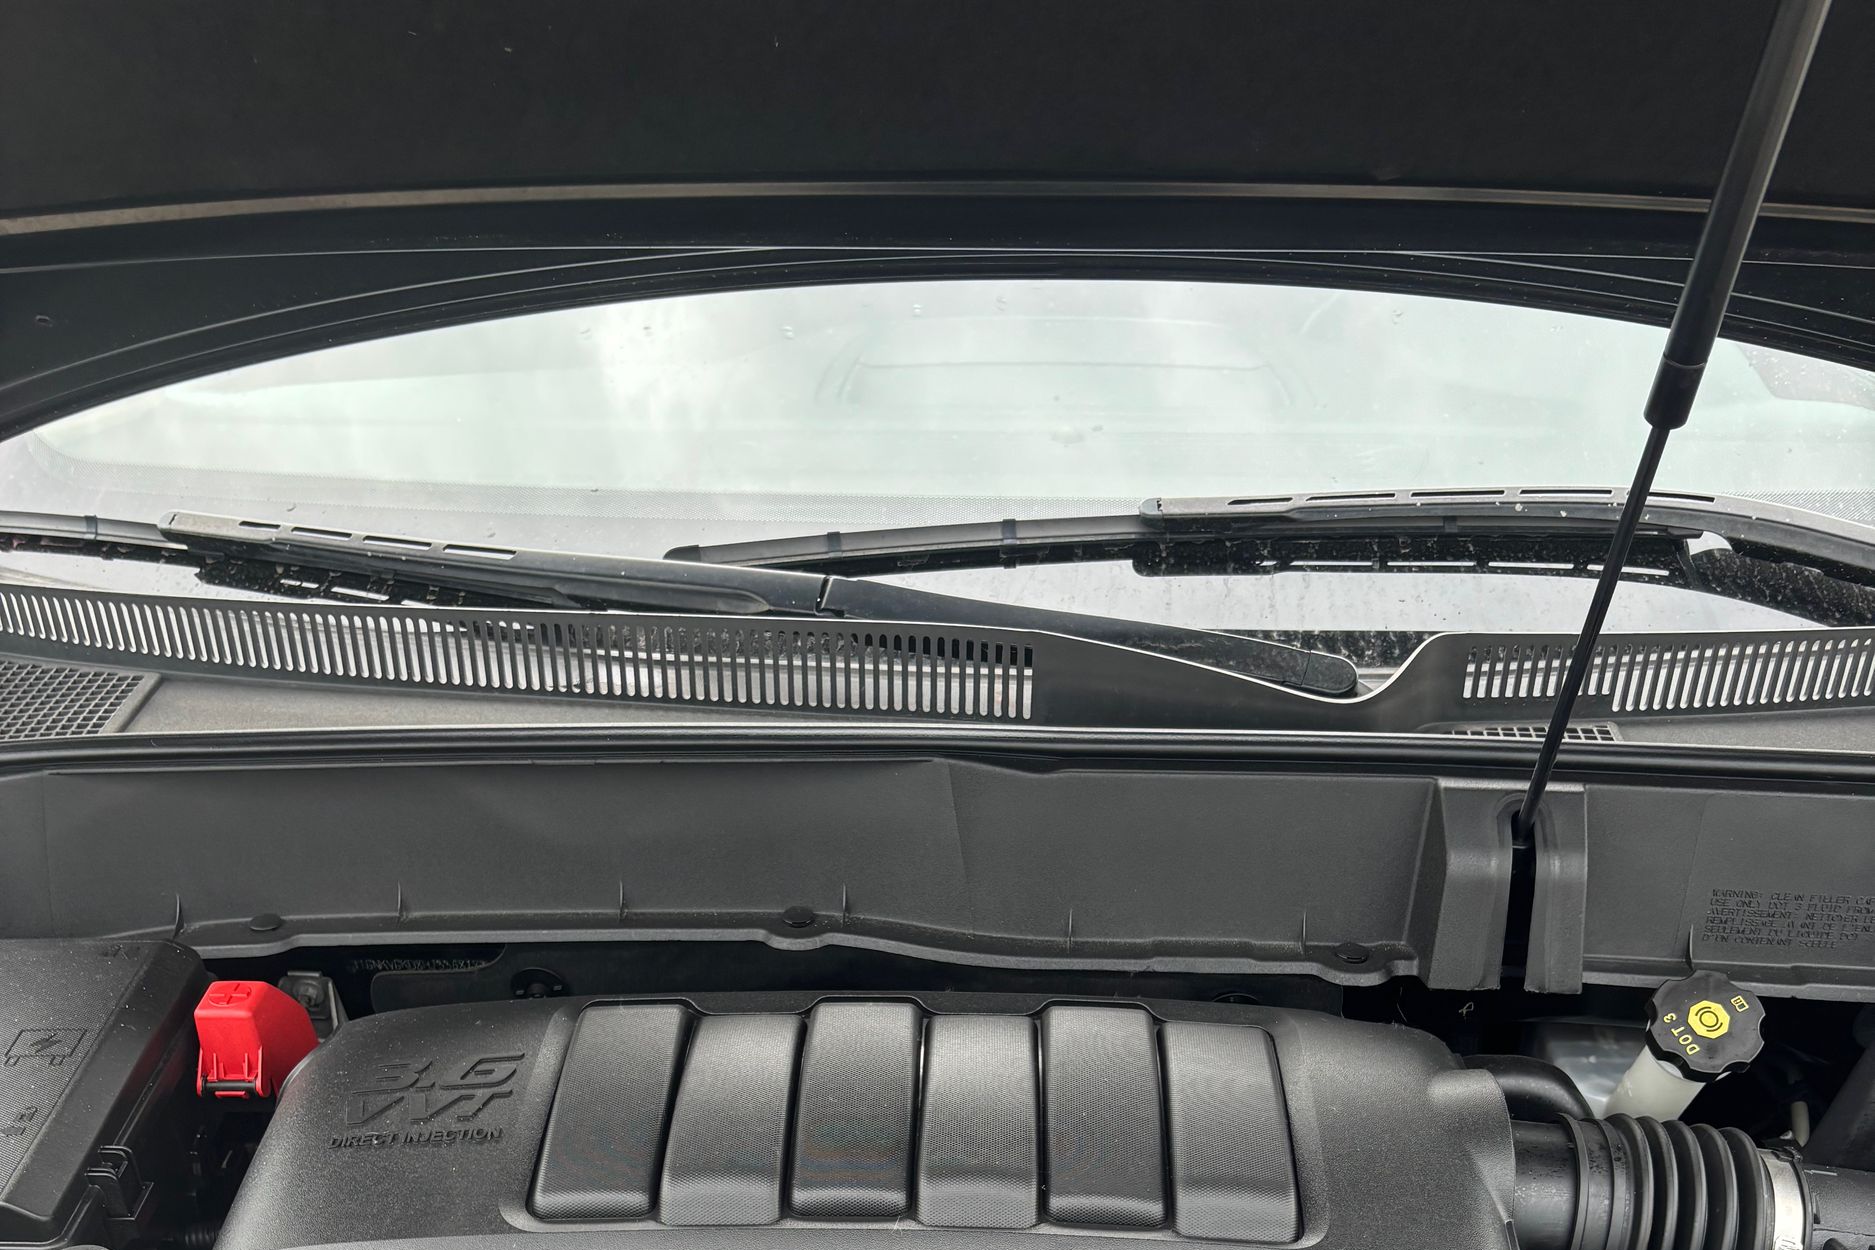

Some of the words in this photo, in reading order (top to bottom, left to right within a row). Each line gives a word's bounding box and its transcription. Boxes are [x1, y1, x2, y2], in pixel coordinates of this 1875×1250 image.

[1663, 1012, 1677, 1023] 3
[1670, 1026, 1700, 1056] DOT
[328, 1131, 399, 1149] DIRECT
[402, 1127, 503, 1145] INJECTION
